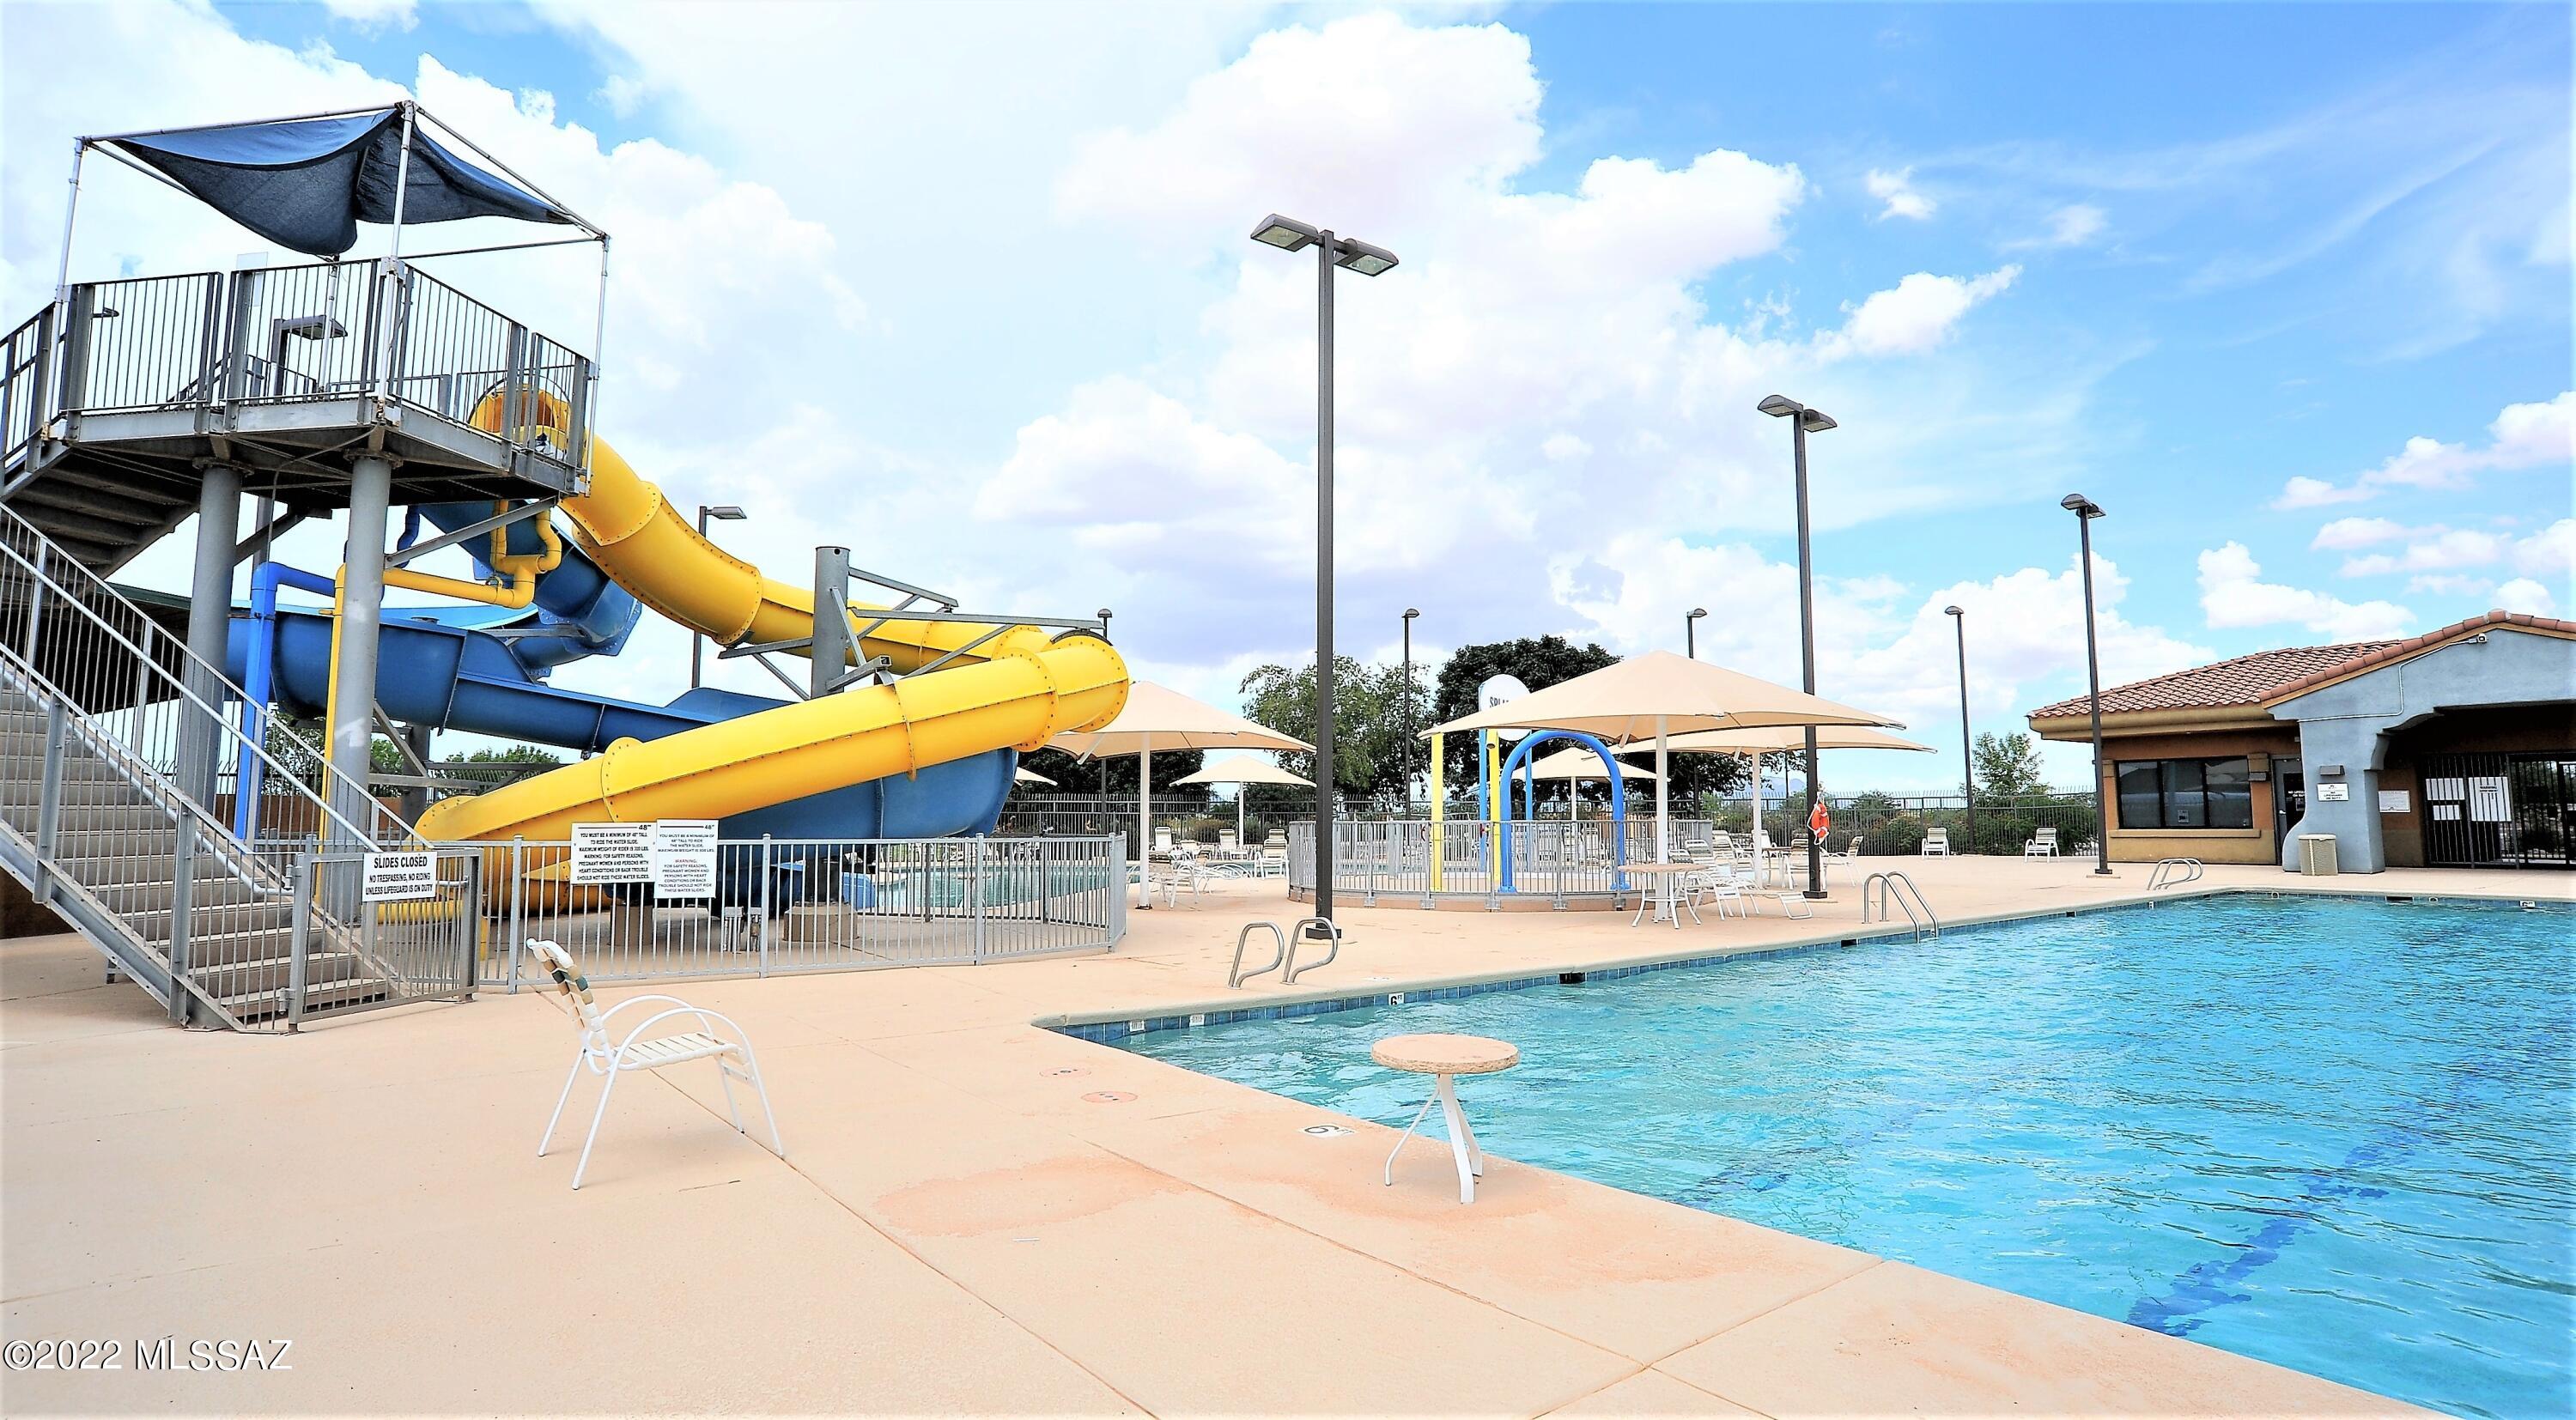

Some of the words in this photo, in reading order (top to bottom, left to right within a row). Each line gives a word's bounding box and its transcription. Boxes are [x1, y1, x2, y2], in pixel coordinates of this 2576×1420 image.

[374, 857, 398, 869] SLIDES
[400, 856, 428, 867] CLOSED
[384, 885, 408, 894] LIFEGUARD
[1391, 996, 1397, 1005] 6
